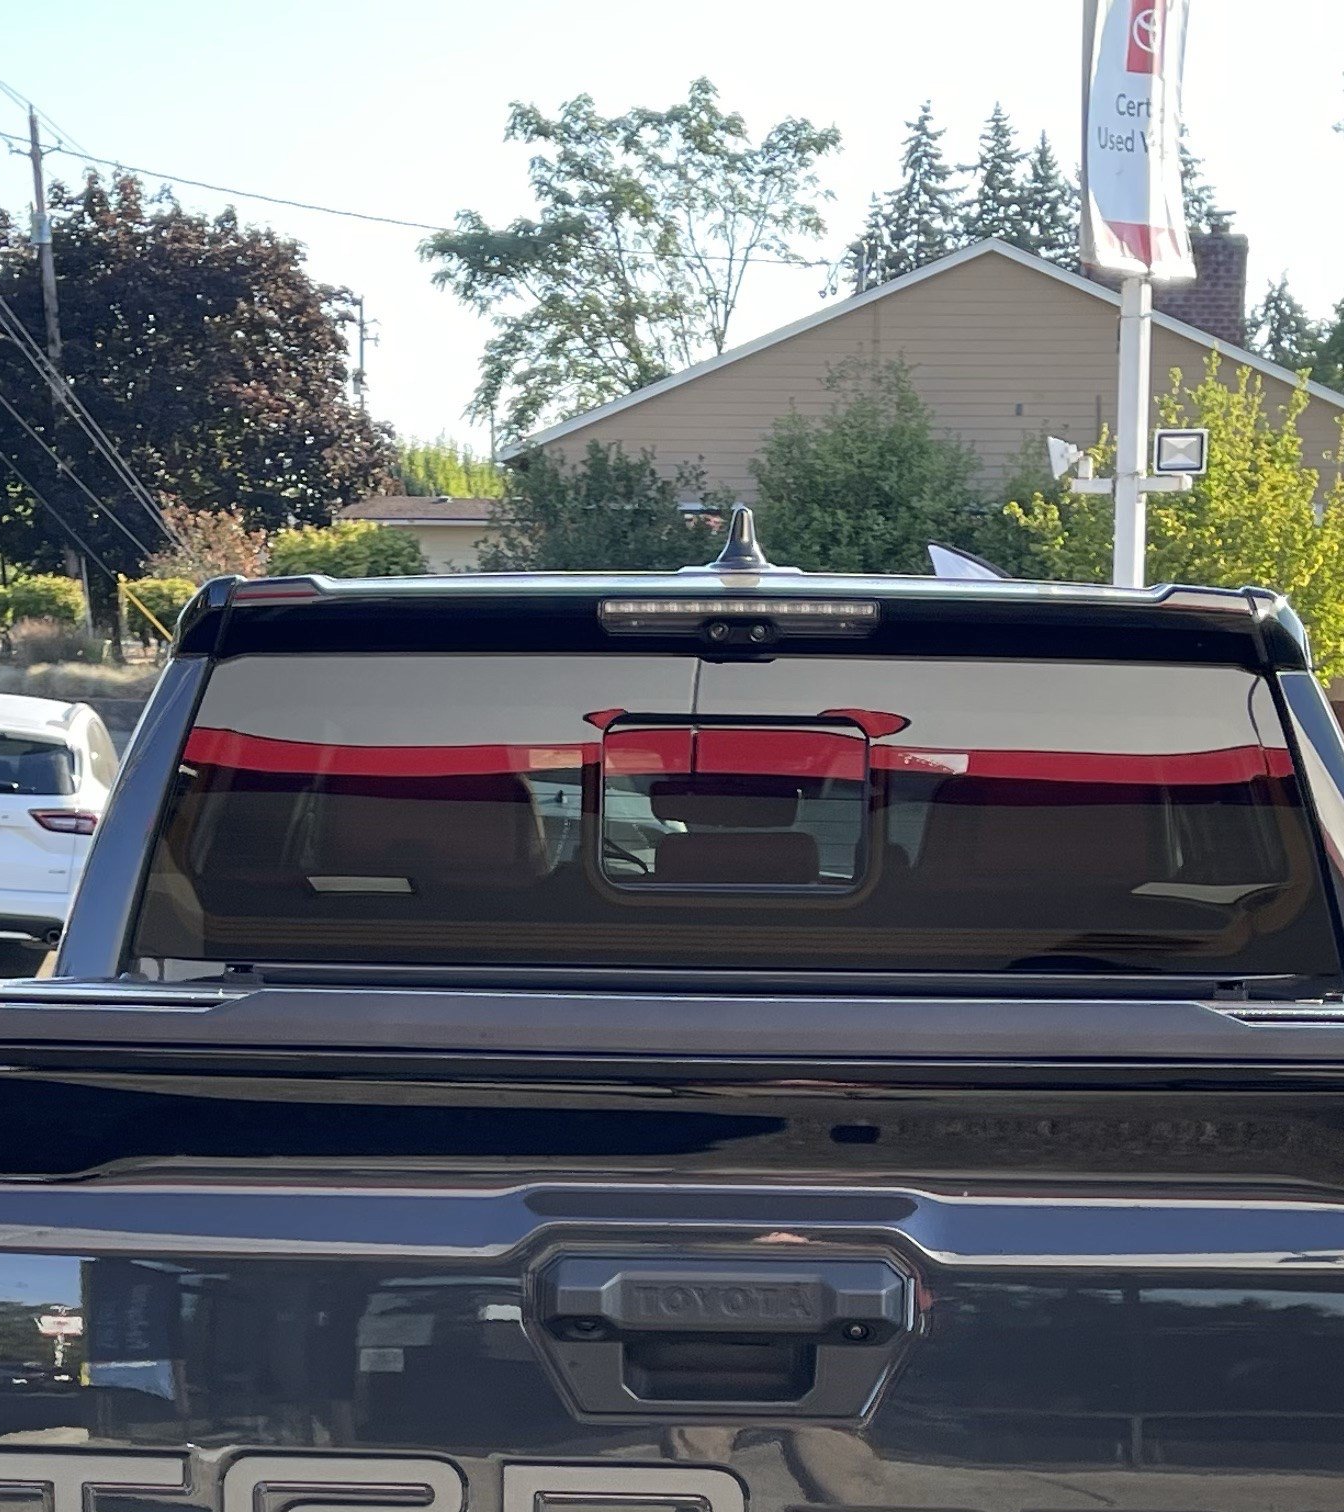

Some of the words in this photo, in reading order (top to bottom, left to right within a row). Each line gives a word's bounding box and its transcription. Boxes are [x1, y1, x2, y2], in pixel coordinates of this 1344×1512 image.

[1115, 93, 1152, 118] Cert
[1098, 126, 1135, 152] Used
[634, 1284, 819, 1321] TOYOTA
